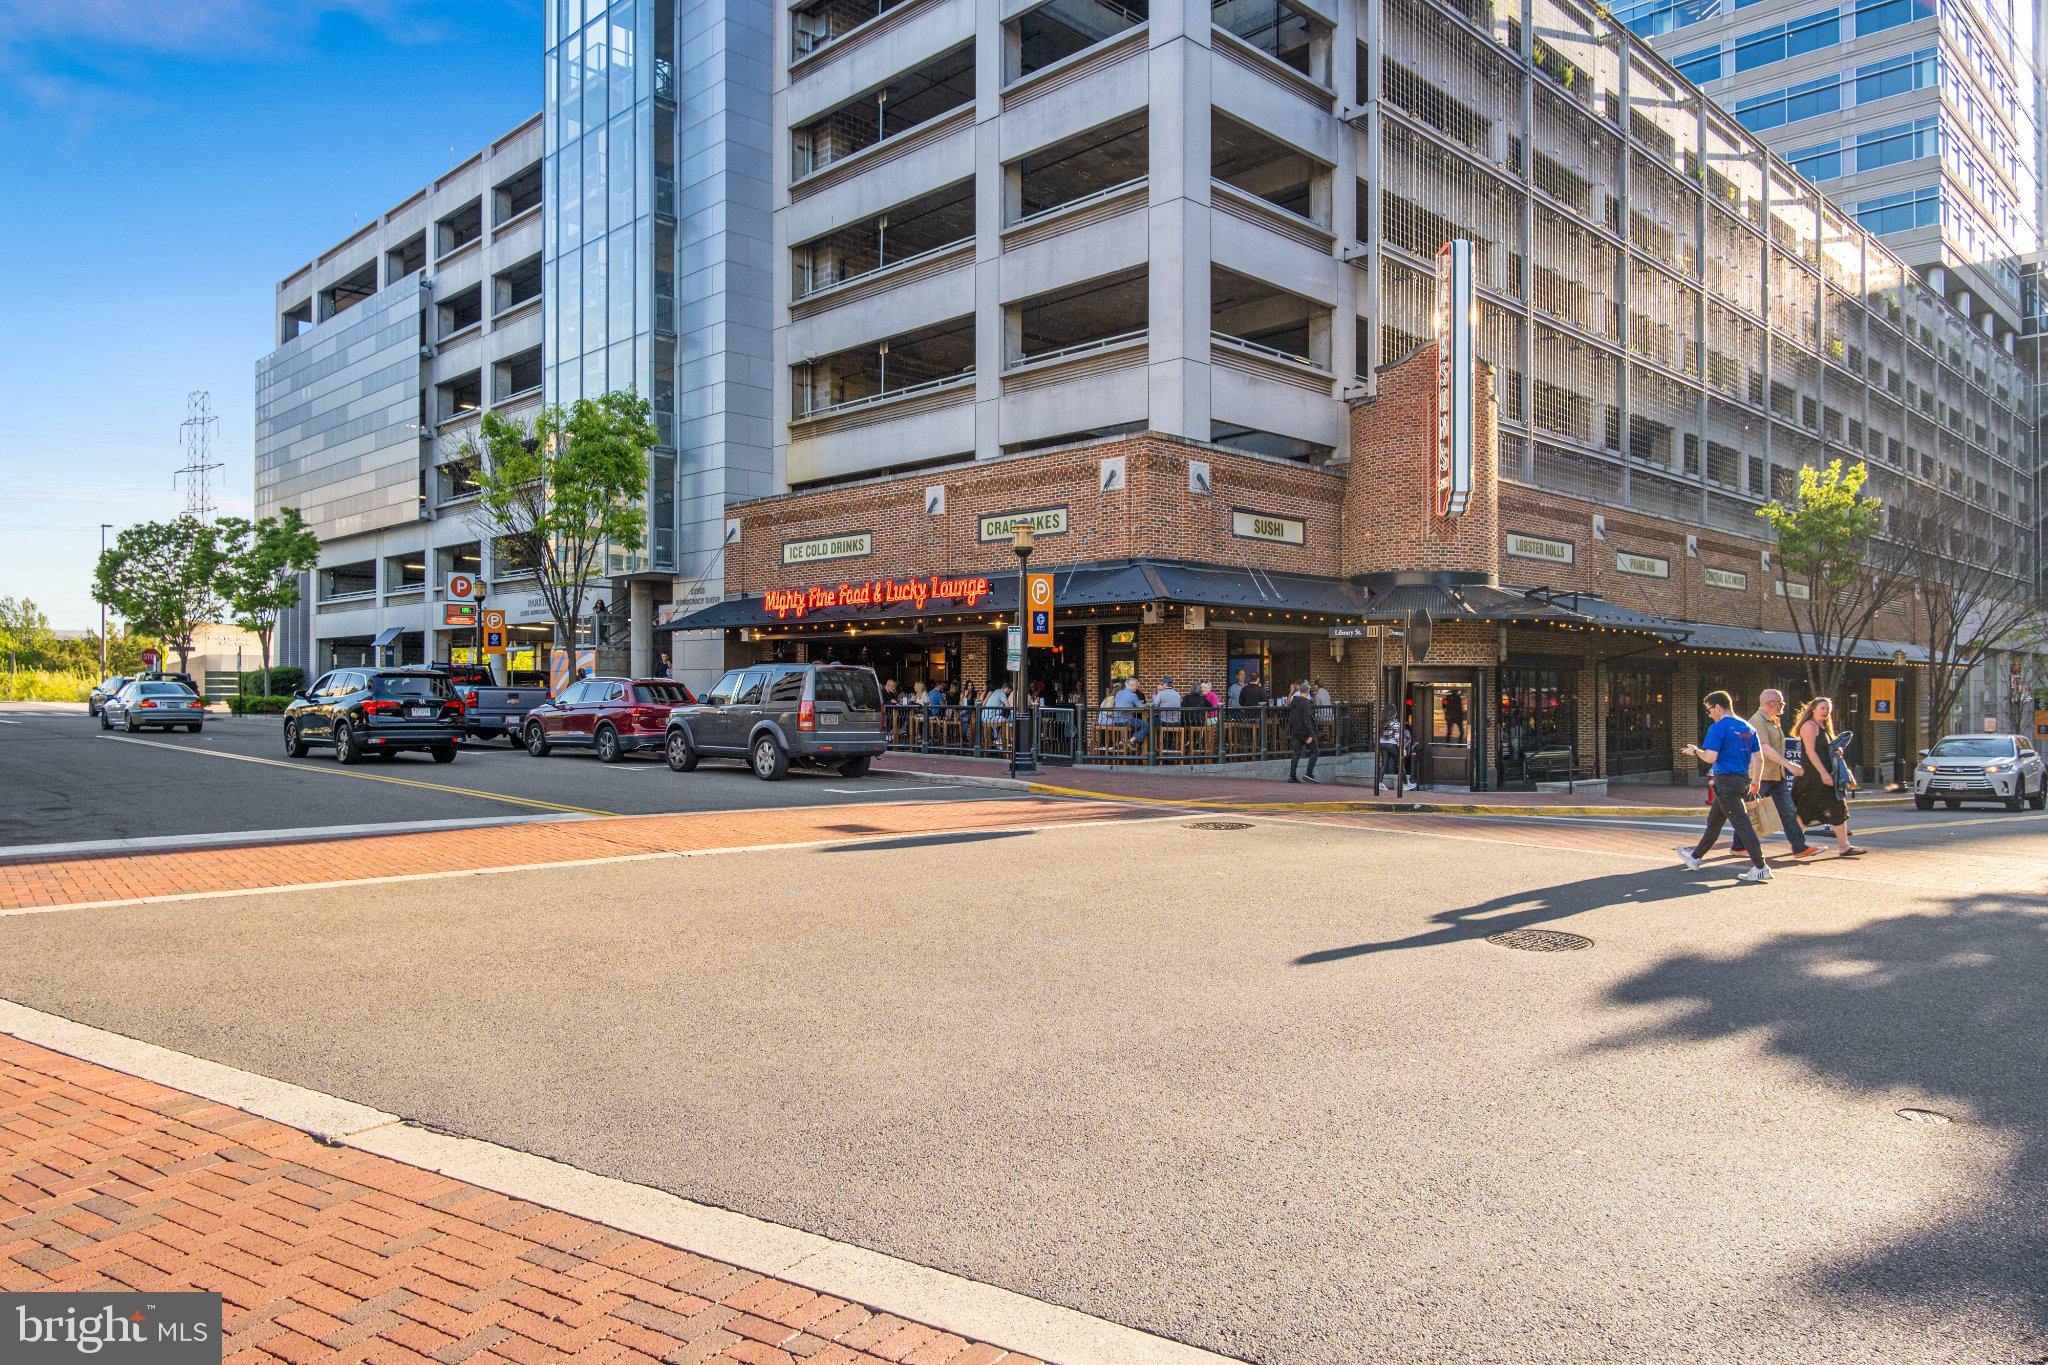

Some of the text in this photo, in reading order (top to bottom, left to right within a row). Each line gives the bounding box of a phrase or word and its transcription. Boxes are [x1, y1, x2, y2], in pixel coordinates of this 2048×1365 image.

[1023, 513, 1060, 531] AKES
[1254, 519, 1284, 537] SUSHI
[789, 538, 865, 559] ICE COLD DRINKS
[1515, 538, 1565, 558] LOBSTER ROLLS
[456, 580, 468, 593] P
[1036, 583, 1046, 599] P
[764, 576, 989, 618] Mighty Fine Food & Lucky Lounge
[490, 616, 500, 626] P
[1334, 629, 1354, 637] Library
